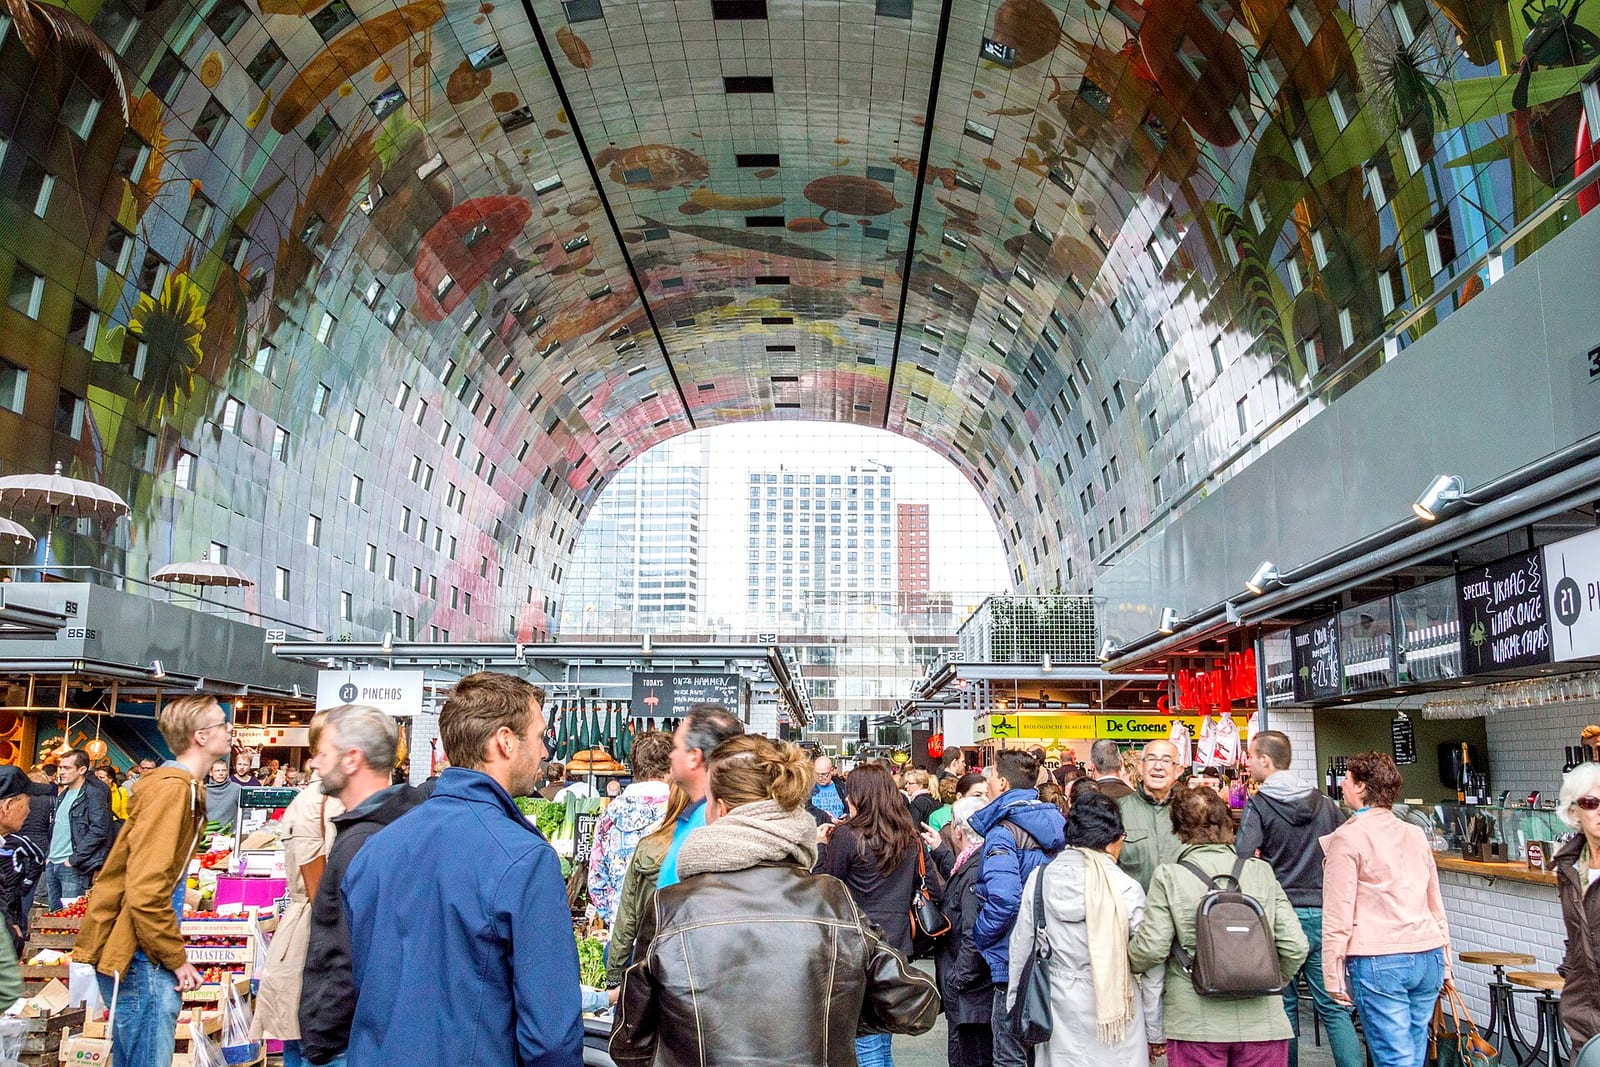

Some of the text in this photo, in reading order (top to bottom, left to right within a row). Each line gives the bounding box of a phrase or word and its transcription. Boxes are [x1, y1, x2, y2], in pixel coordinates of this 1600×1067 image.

[1463, 569, 1526, 605] SPECIAL VRAAG
[65, 601, 78, 614] 89
[1561, 587, 1575, 616] 21
[1517, 594, 1542, 626] ONZE
[67, 628, 85, 638] 86
[1491, 622, 1549, 663] WARME TAPAS
[949, 652, 964, 660] 32
[643, 679, 664, 687] TODAYS
[694, 676, 732, 686] HAMMEN
[343, 687, 353, 699] 21
[362, 687, 402, 700] PINCHOS
[1106, 719, 1123, 732] De
[1126, 719, 1167, 732] Groene
[578, 821, 594, 833] UIT
